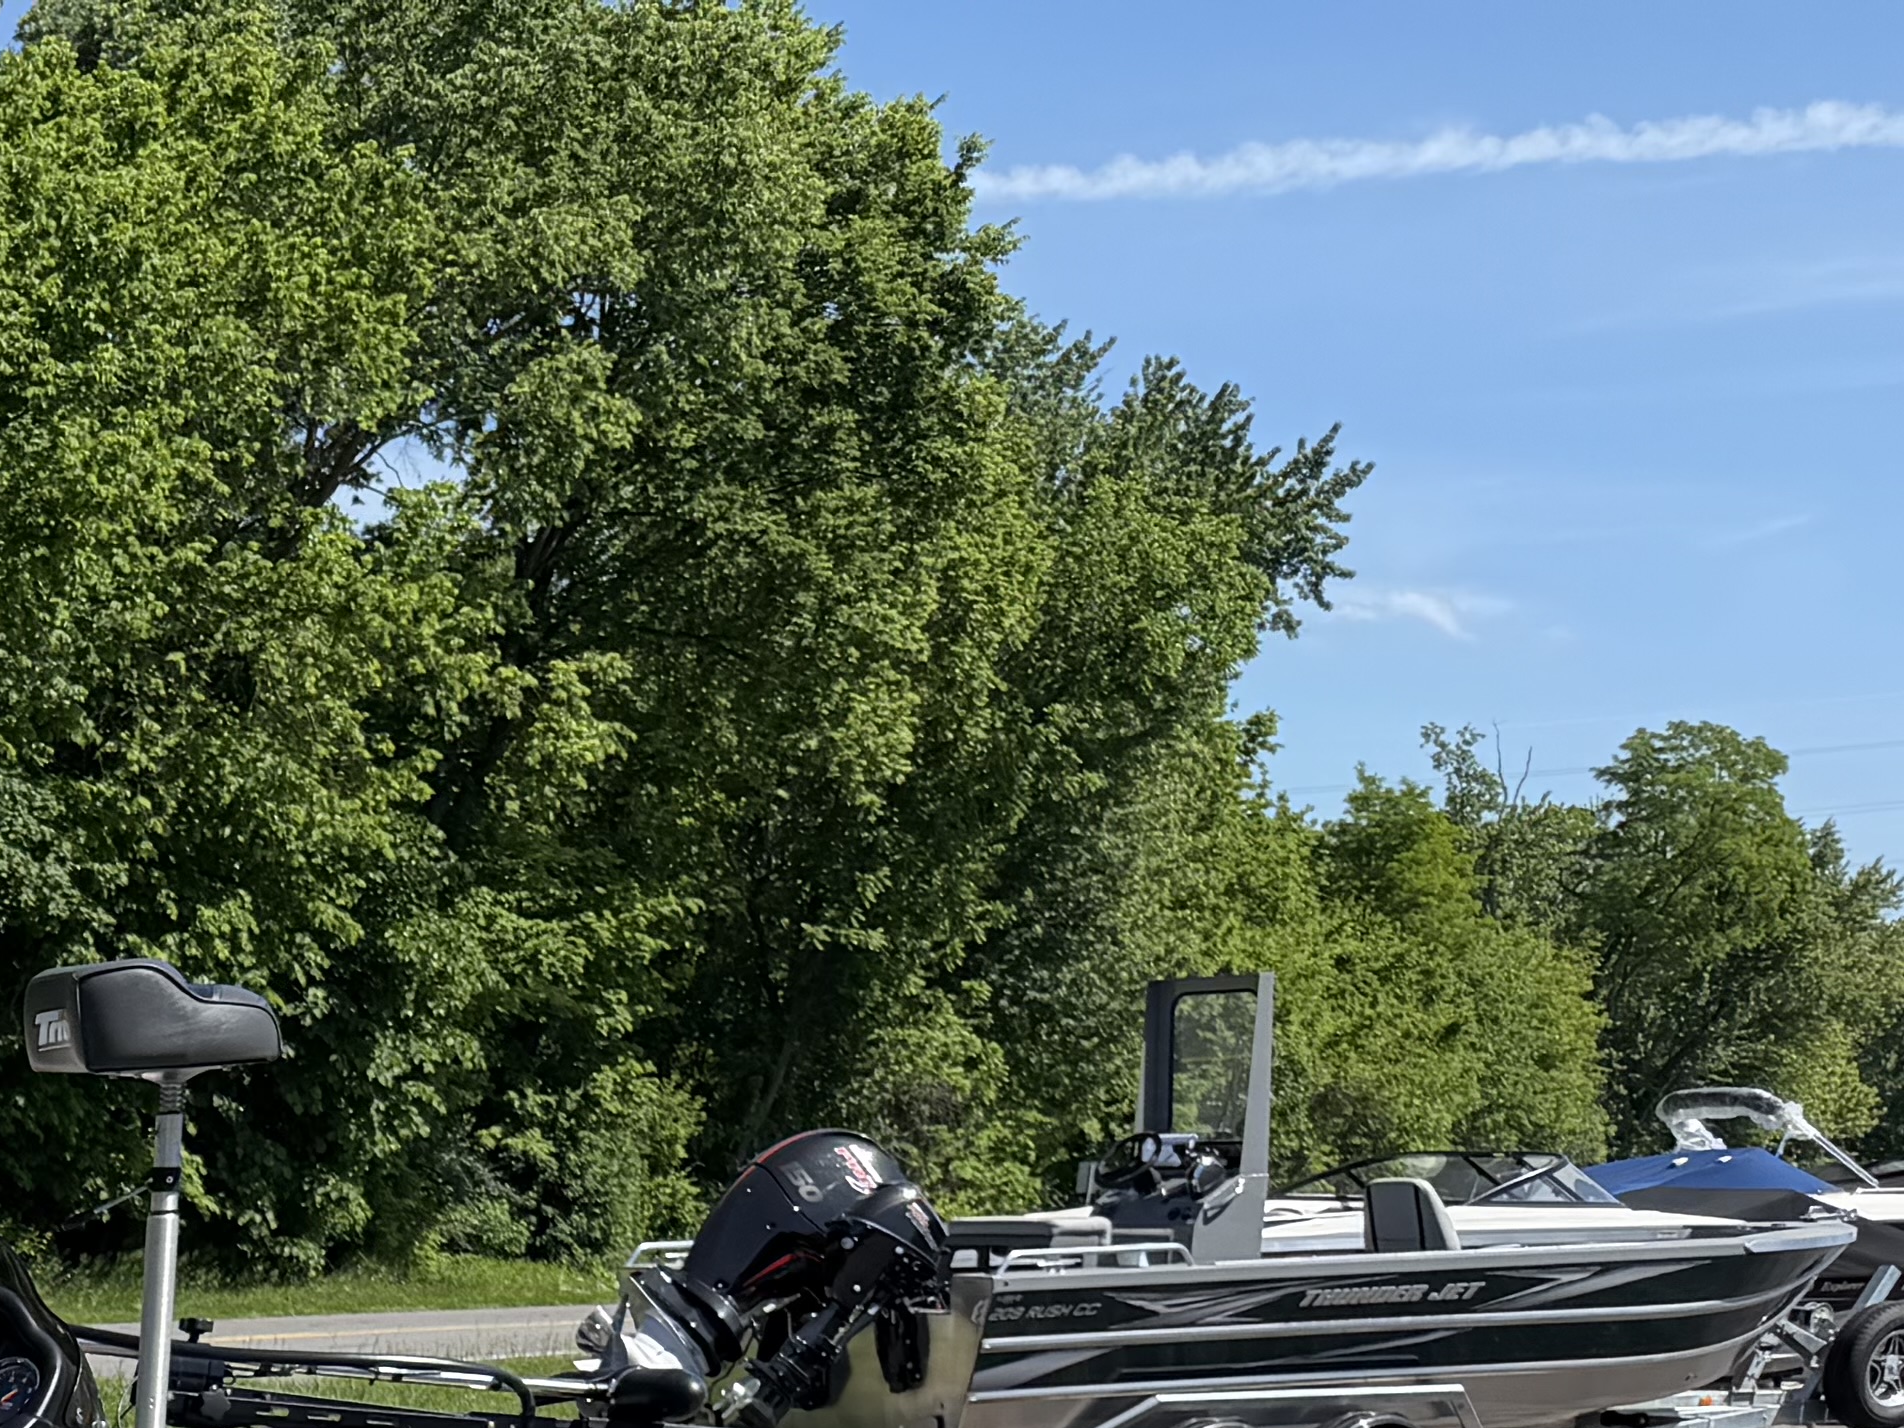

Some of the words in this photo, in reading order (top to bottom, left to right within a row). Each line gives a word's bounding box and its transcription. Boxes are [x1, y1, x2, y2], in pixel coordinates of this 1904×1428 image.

[1299, 1284, 1429, 1308] THUNDER
[1427, 1281, 1486, 1301] JET
[1072, 1303, 1102, 1317] CC
